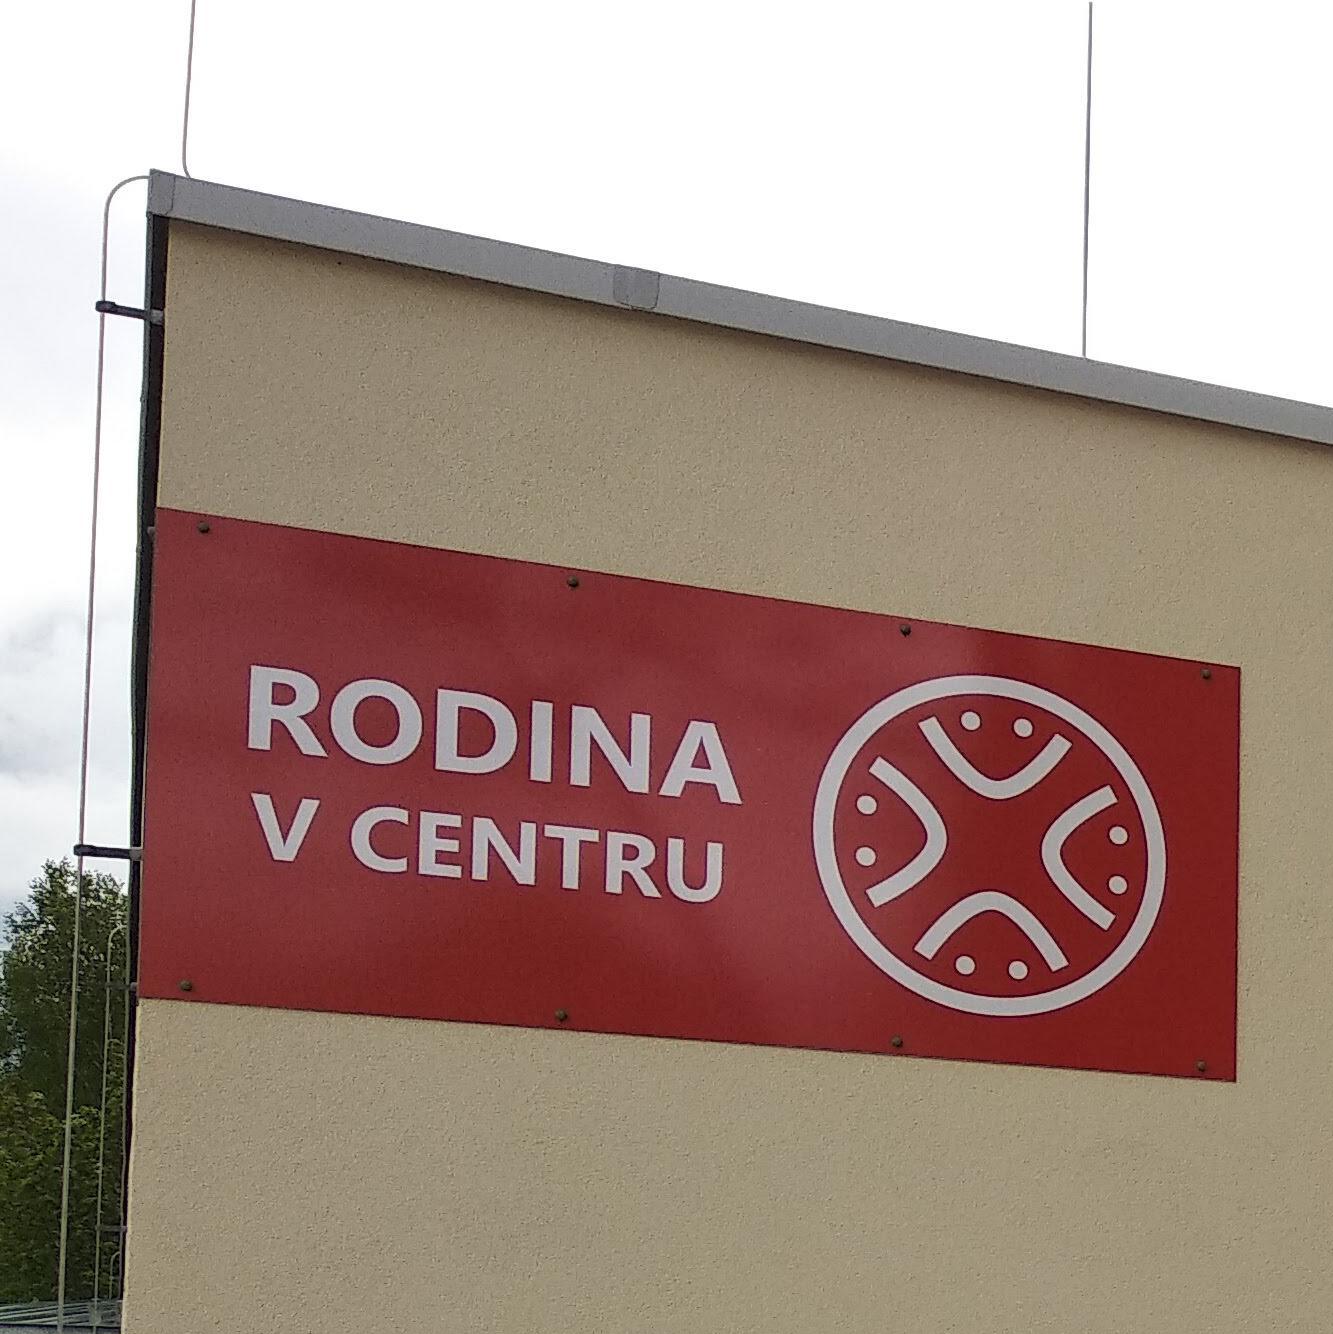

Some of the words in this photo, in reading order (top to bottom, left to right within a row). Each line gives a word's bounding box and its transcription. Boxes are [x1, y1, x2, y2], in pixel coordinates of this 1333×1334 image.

[248, 664, 743, 805] RODINA
[250, 792, 321, 862] V
[349, 805, 724, 903] CENTRU
